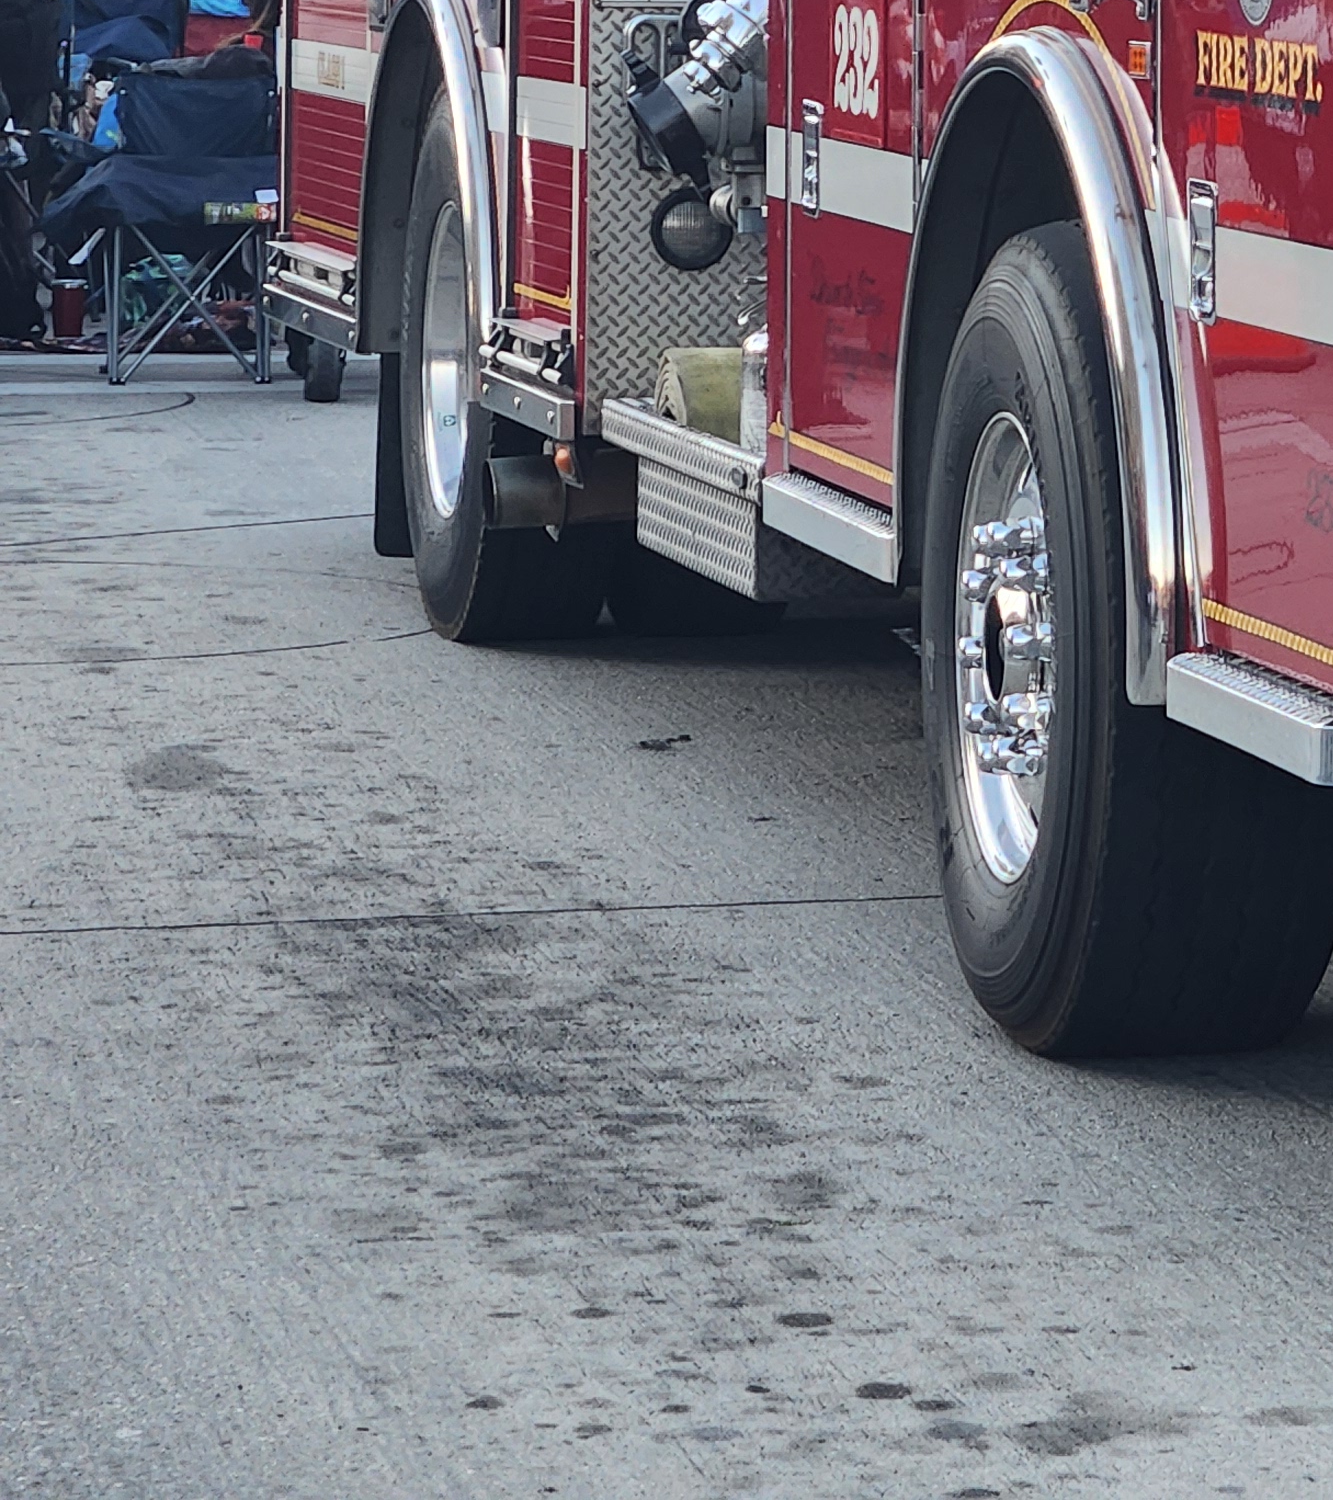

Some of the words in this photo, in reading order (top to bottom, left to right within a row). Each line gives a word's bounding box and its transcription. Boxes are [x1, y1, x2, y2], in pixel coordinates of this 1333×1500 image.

[834, 3, 879, 120] 232
[1196, 29, 1249, 92] FIRE
[1253, 37, 1323, 104] DEPT.
